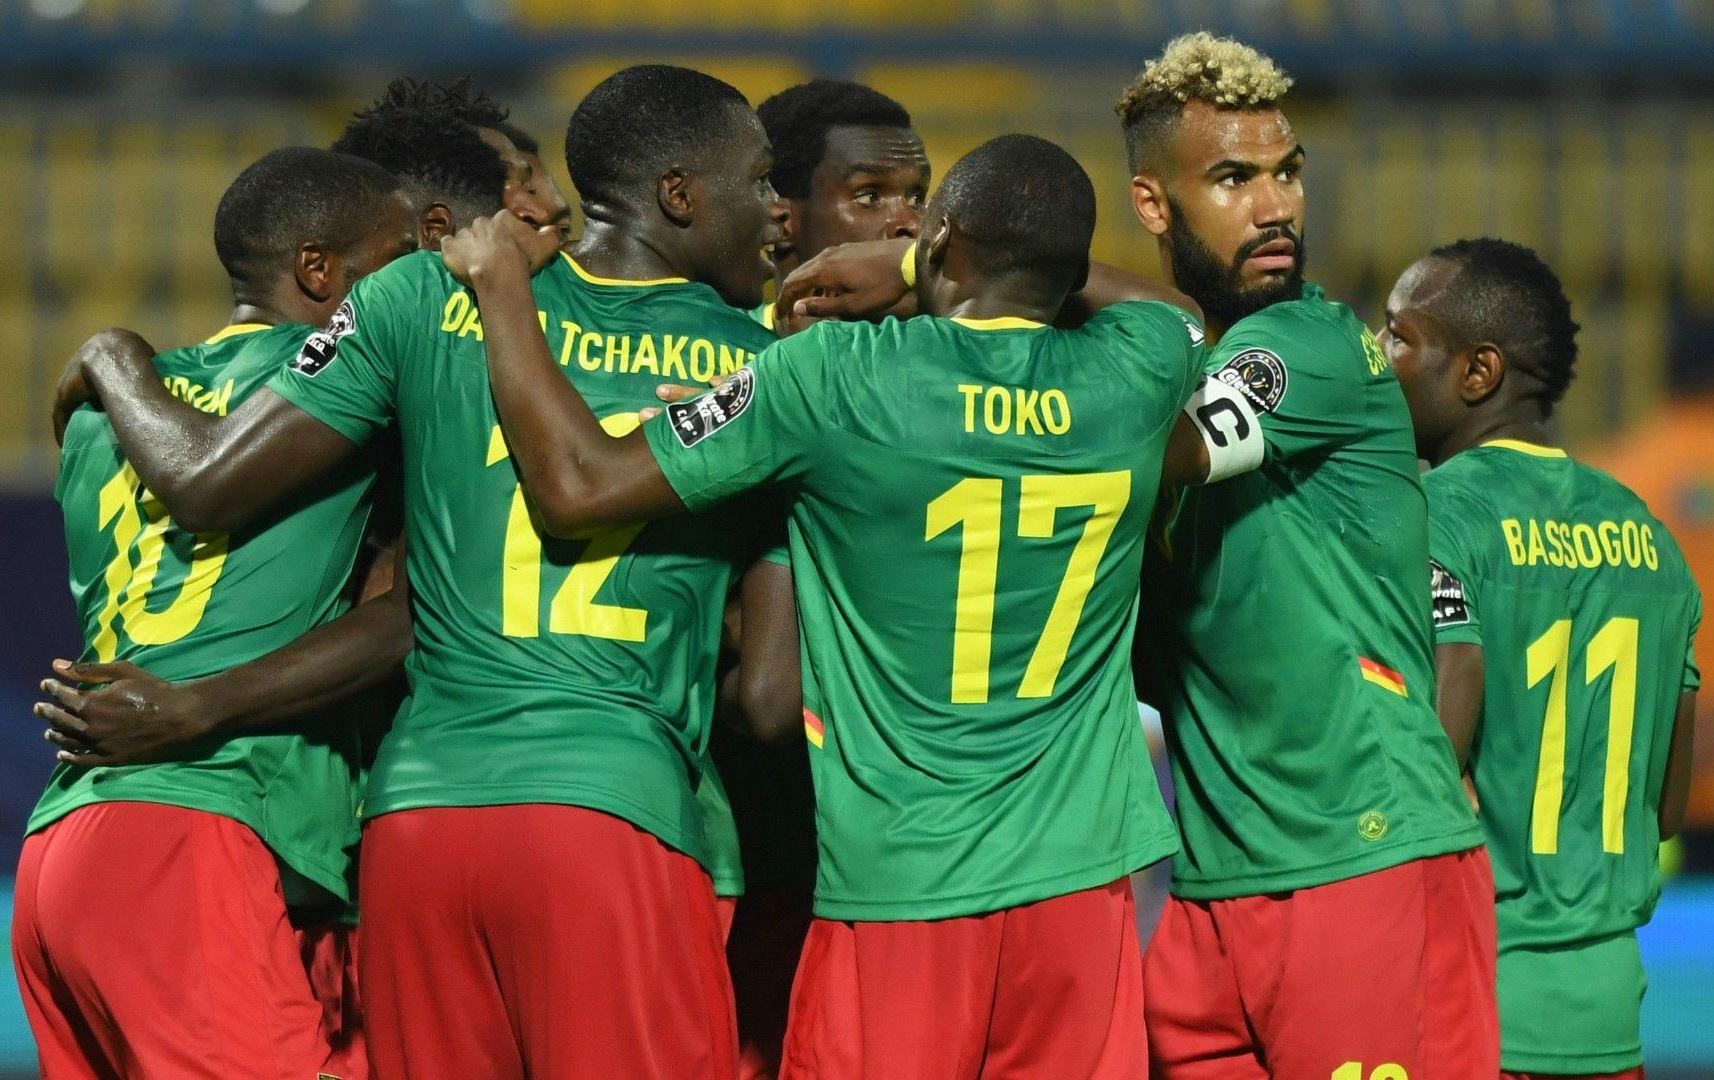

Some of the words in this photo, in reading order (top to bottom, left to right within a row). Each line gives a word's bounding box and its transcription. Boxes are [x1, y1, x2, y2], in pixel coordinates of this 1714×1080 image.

[559, 320, 756, 381] TCHAKON
[958, 384, 1072, 436] TOKO
[1197, 398, 1250, 447] C
[1501, 519, 1658, 571] BASSOGOG
[924, 470, 1132, 704] 17
[1526, 617, 1639, 855] 11
